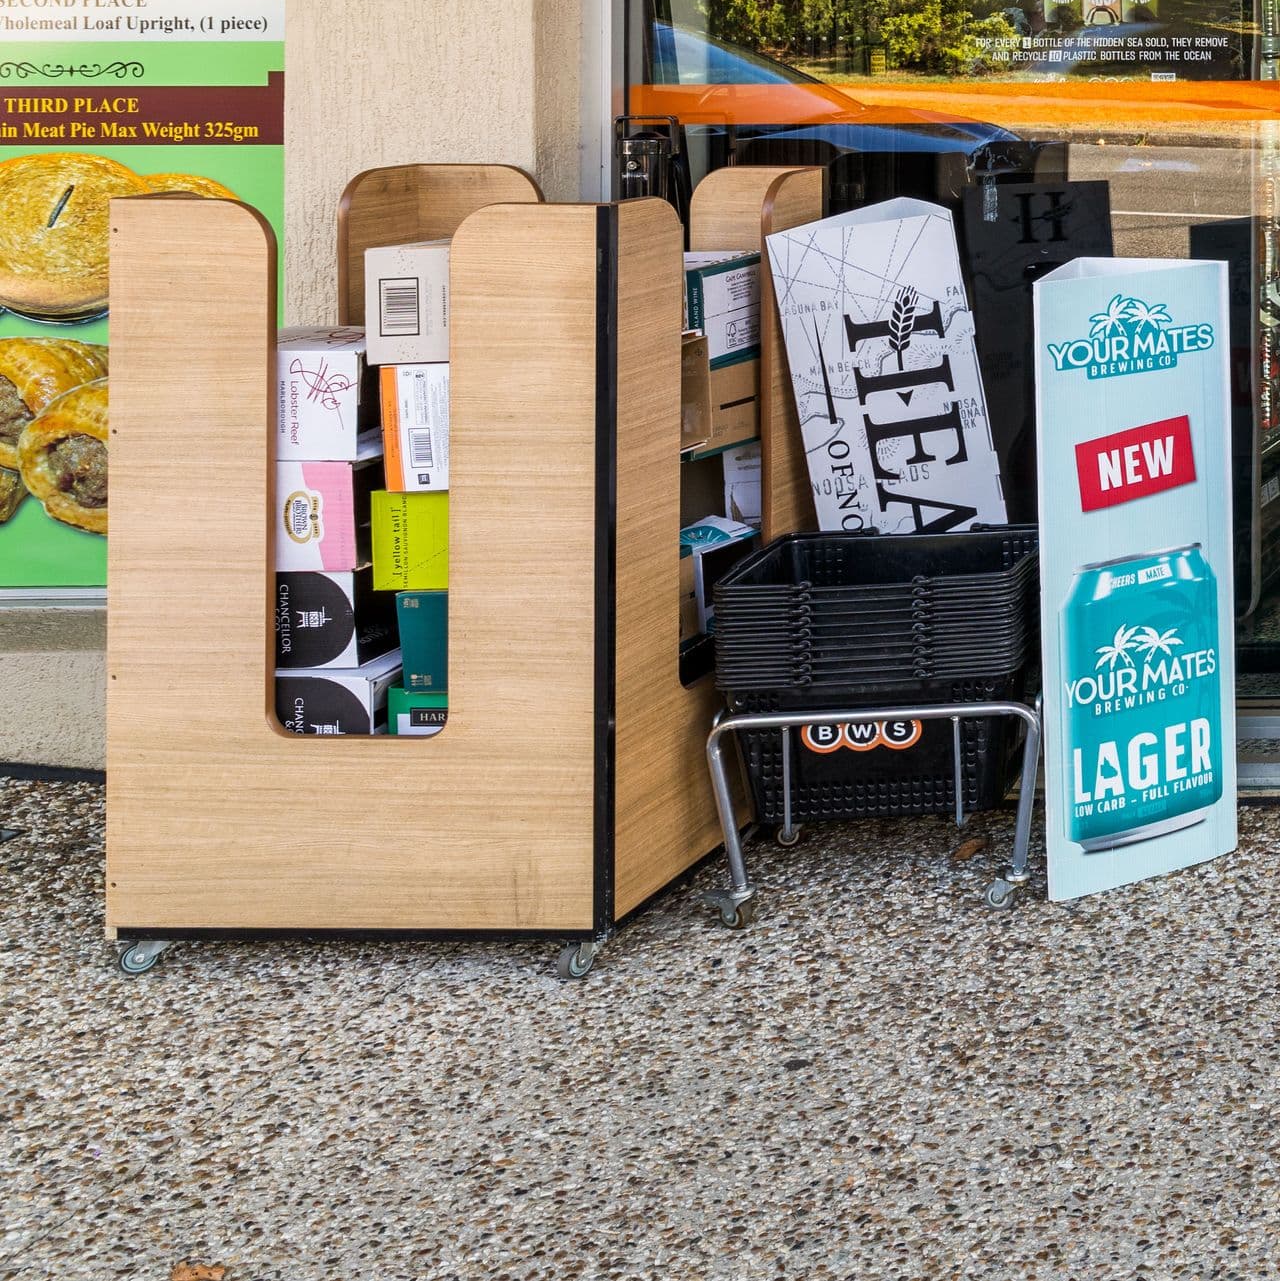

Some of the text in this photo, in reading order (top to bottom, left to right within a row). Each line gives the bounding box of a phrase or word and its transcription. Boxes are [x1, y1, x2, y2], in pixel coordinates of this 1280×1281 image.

[84, 16, 122, 30] Loaf
[127, 16, 195, 33] Upright,
[220, 16, 268, 33] piece)
[975, 38, 990, 48] FOR
[994, 38, 1021, 48] EVERY
[1034, 38, 1062, 48] BOTTLE
[1065, 38, 1075, 48] OF
[1076, 38, 1091, 48] THE
[1093, 38, 1123, 48] HIDDEN
[1127, 38, 1143, 48] SEA
[1145, 38, 1169, 49] SOLD,
[1172, 38, 1192, 48] THEY
[1195, 38, 1228, 48] REMOVE
[992, 51, 1009, 61] AND
[1013, 51, 1047, 61] RECYCLE
[1063, 51, 1097, 61] PLASTIC
[1101, 51, 1135, 61] BOTTLES
[1139, 51, 1161, 61] FROM
[1165, 51, 1180, 61] THE
[1184, 51, 1211, 61] OCEAN
[5, 98, 139, 113] THIRD PLACE
[23, 122, 65, 138] Meat
[70, 122, 96, 138] Pie
[100, 122, 137, 138] Max
[141, 122, 200, 142] Weight
[204, 122, 258, 142] 325gm
[1049, 325, 1212, 369] YOUR MATES
[1091, 359, 1153, 376] BREWING
[290, 381, 299, 445] Lobster Reef
[1097, 436, 1174, 491] NEW
[1145, 567, 1165, 580] MATE
[279, 584, 291, 654] CHANCELLOR
[1065, 648, 1215, 709] YOUR MATES
[1095, 690, 1166, 715] BREWING
[1074, 717, 1212, 804] LAGER
[1075, 804, 1093, 818] LOW
[1097, 798, 1125, 814] CARB
[1142, 787, 1169, 802] FULL
[1174, 772, 1213, 794] FLAVOUR
